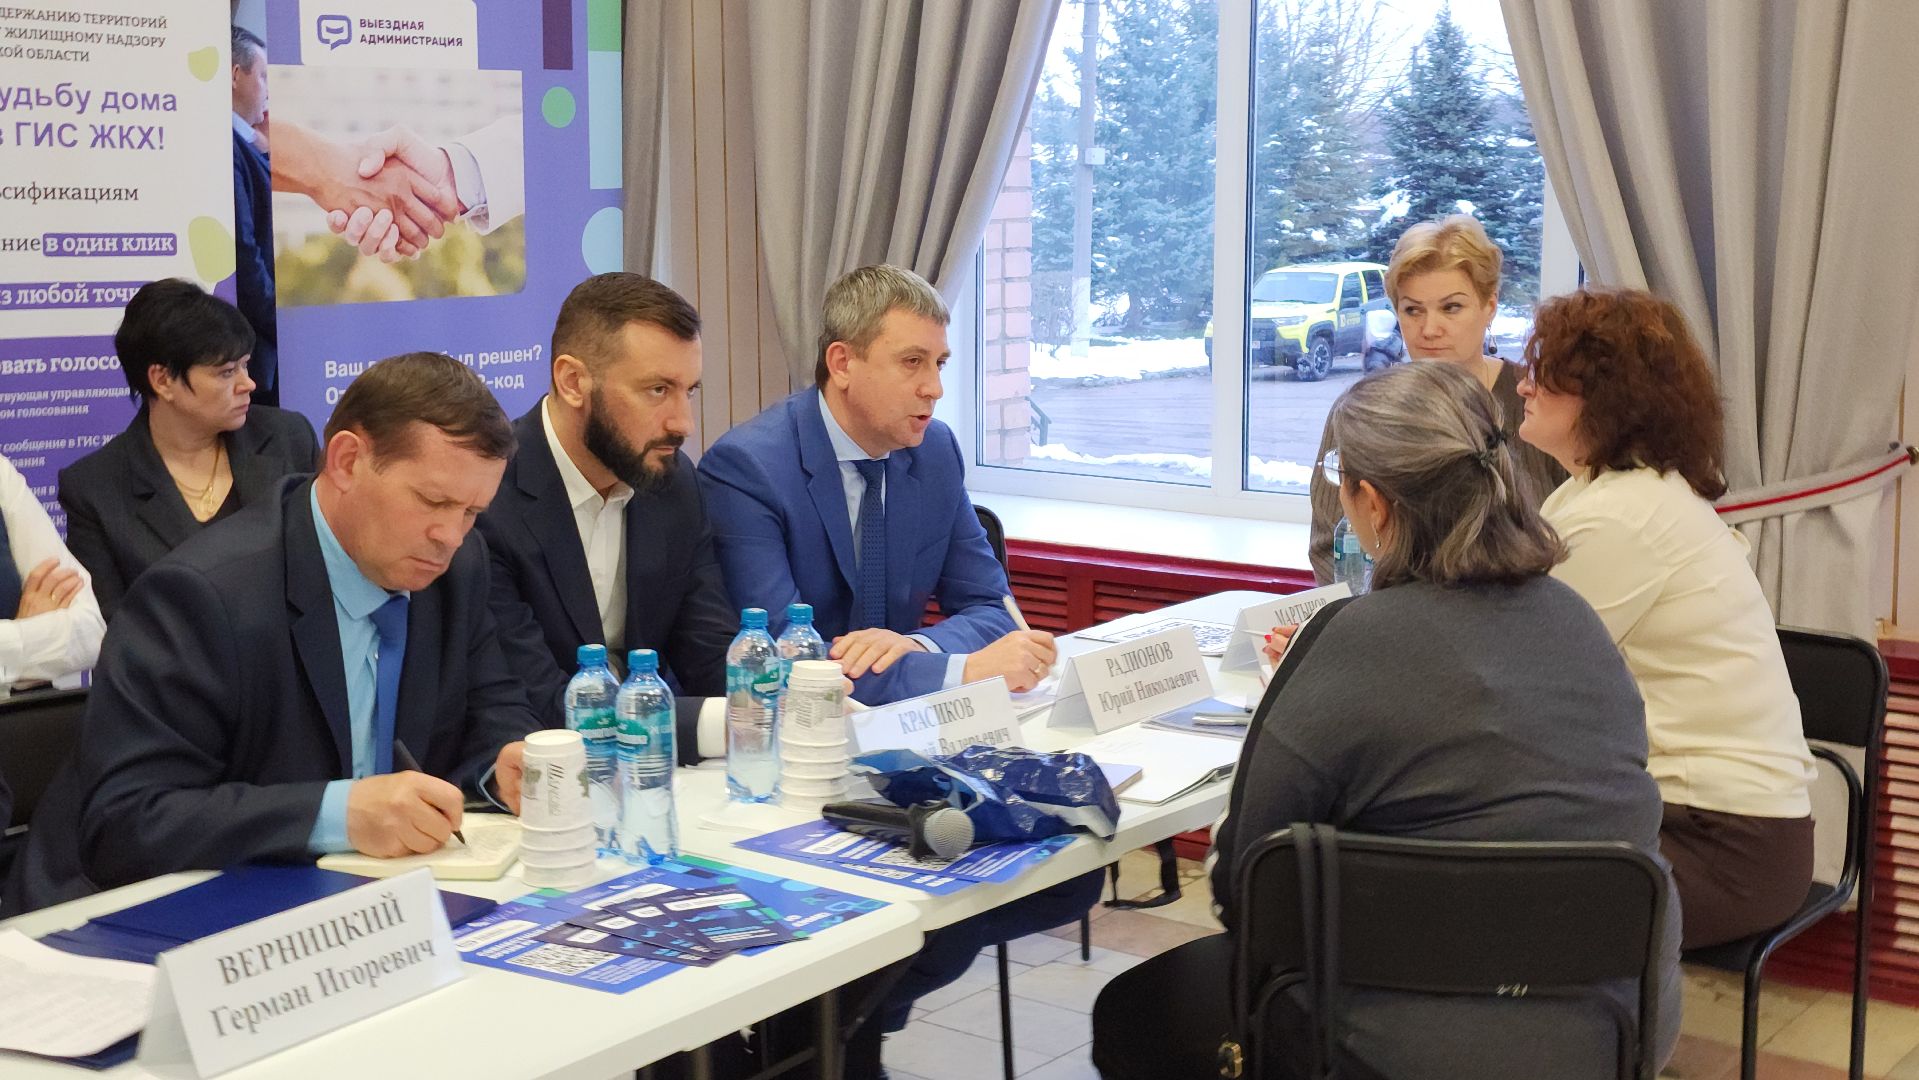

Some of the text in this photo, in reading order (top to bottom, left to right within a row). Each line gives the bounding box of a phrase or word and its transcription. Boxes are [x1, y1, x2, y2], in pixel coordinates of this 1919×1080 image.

[83, 13, 168, 29] ТЕРРИТОРИЙ
[360, 18, 424, 31] ВЫЕЗДНАЯ
[5, 27, 167, 48] ЖИЛИЩНОМУ НАДЗОРУ
[360, 34, 463, 48] АДМИНИСТРАЦИЯ
[26, 47, 90, 62] ОБЛАСТИ
[0, 82, 178, 115] удьбу дома
[15, 121, 79, 148] ГИС
[89, 123, 165, 150] ЖКХ!
[0, 181, 139, 205] сификациям
[1, 237, 175, 255] ние в один клик
[0, 290, 12, 305] з
[16, 282, 90, 305] любой
[0, 355, 121, 375] вать голосо
[325, 360, 363, 378] Ваш
[478, 344, 542, 369] решен?
[50, 386, 131, 403] управляющая
[16, 404, 89, 418] голосования
[3, 439, 66, 453] сообщение
[68, 438, 76, 449] в
[77, 435, 101, 448] ГИС
[8, 456, 46, 468] рания
[1105, 641, 1174, 678] РАДИОНОВ
[1098, 669, 1200, 714] Юрий Николаевич
[897, 697, 975, 735] КРАСИКОВ
[217, 891, 406, 986] ВЕРНИЦКИЙ
[209, 985, 314, 1037] Герман
[313, 939, 438, 998] Игоревич
